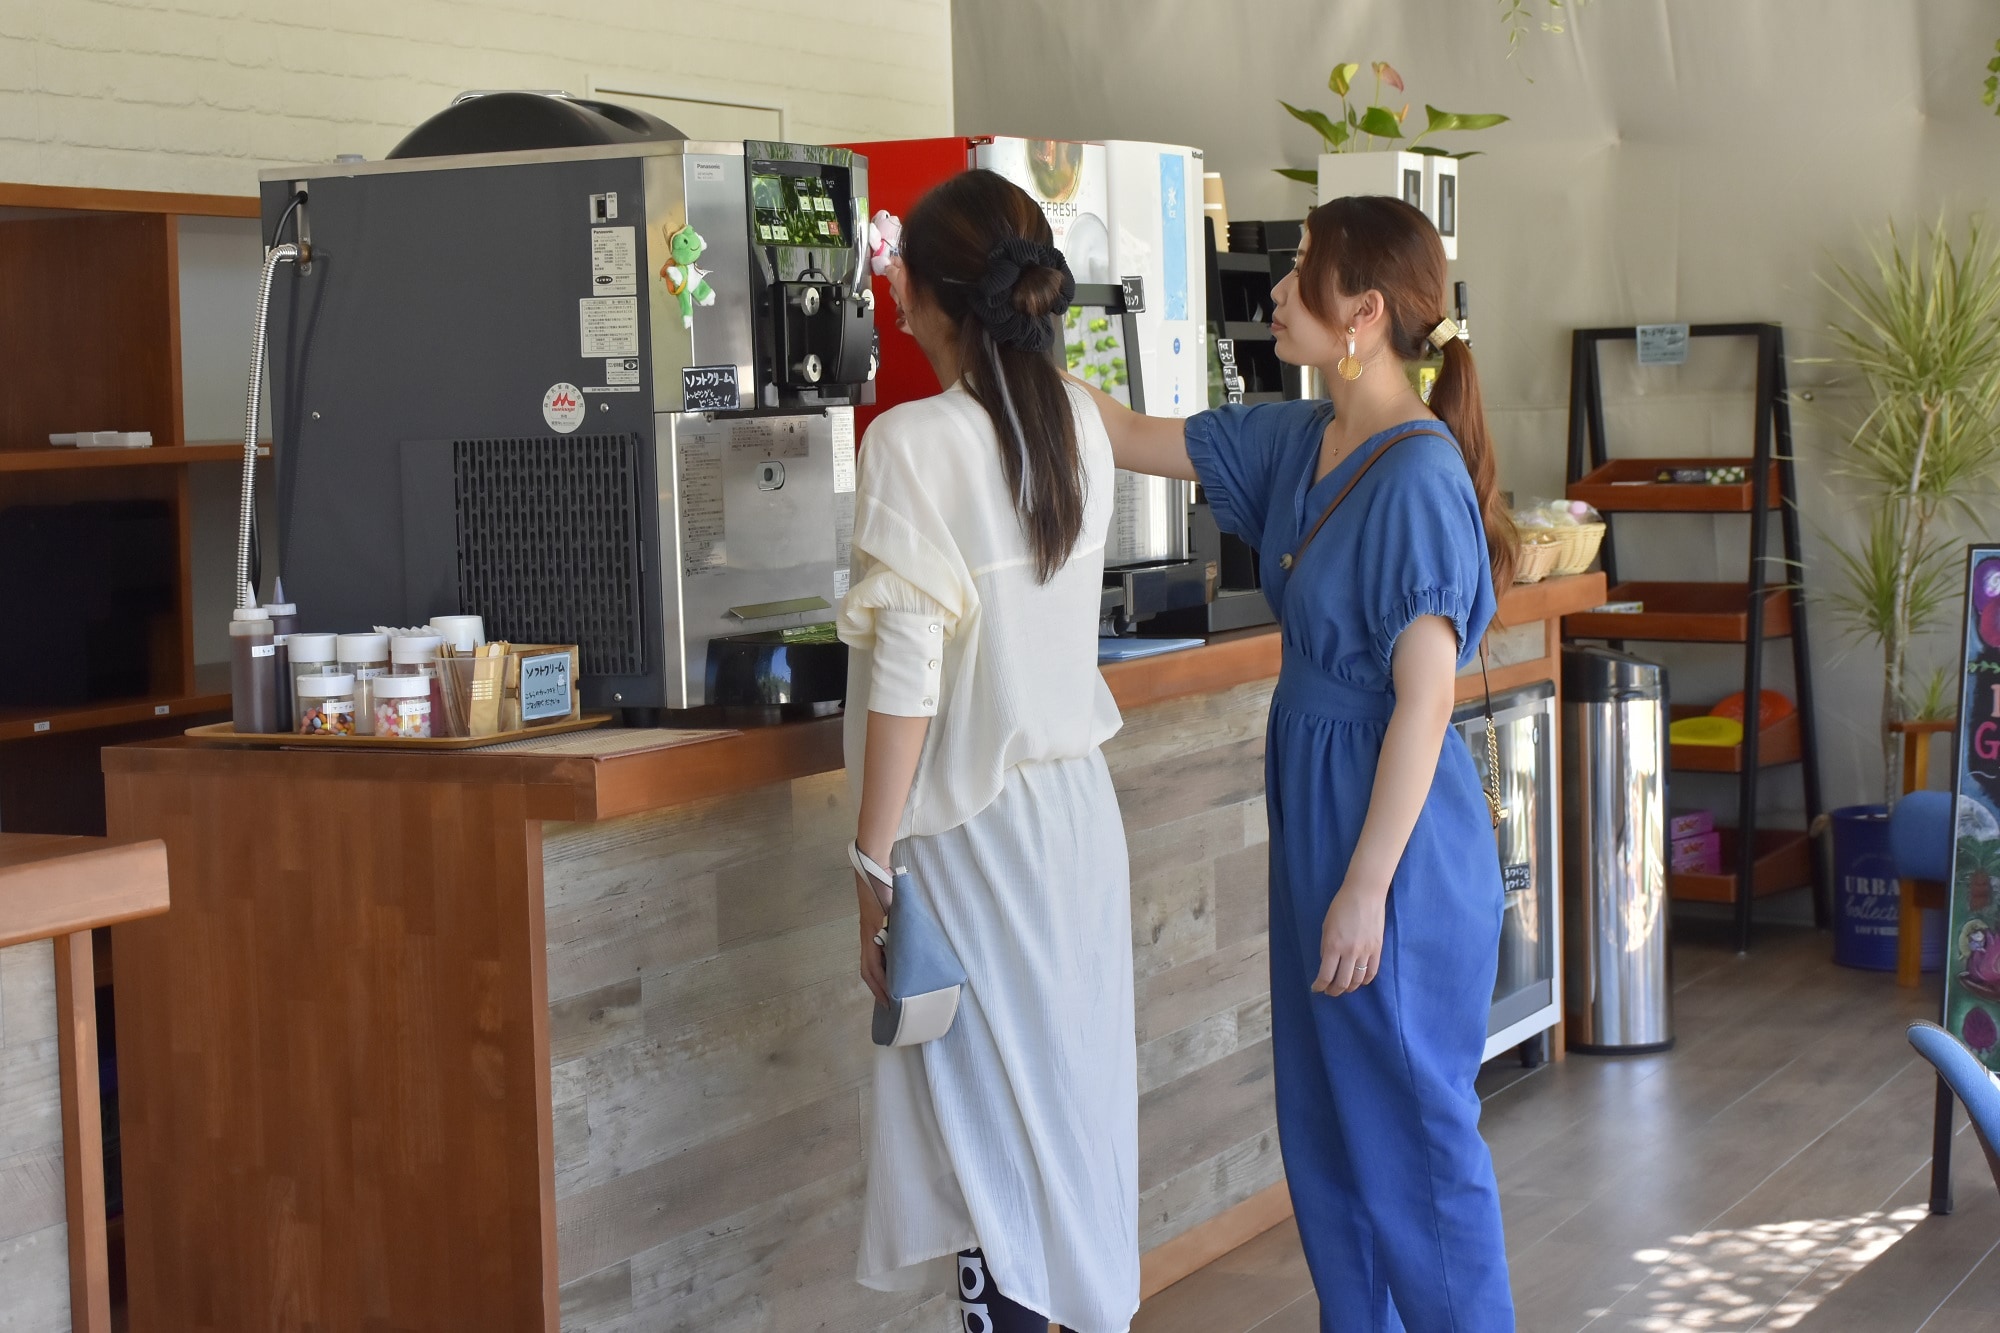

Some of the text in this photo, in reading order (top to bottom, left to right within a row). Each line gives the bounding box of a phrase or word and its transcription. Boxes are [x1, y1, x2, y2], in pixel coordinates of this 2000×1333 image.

[1040, 201, 1078, 217] EFRESH
[685, 372, 735, 388] ソフトクリーム
[526, 661, 566, 679] ソフトクリーム
[1845, 876, 1900, 896] URBA
